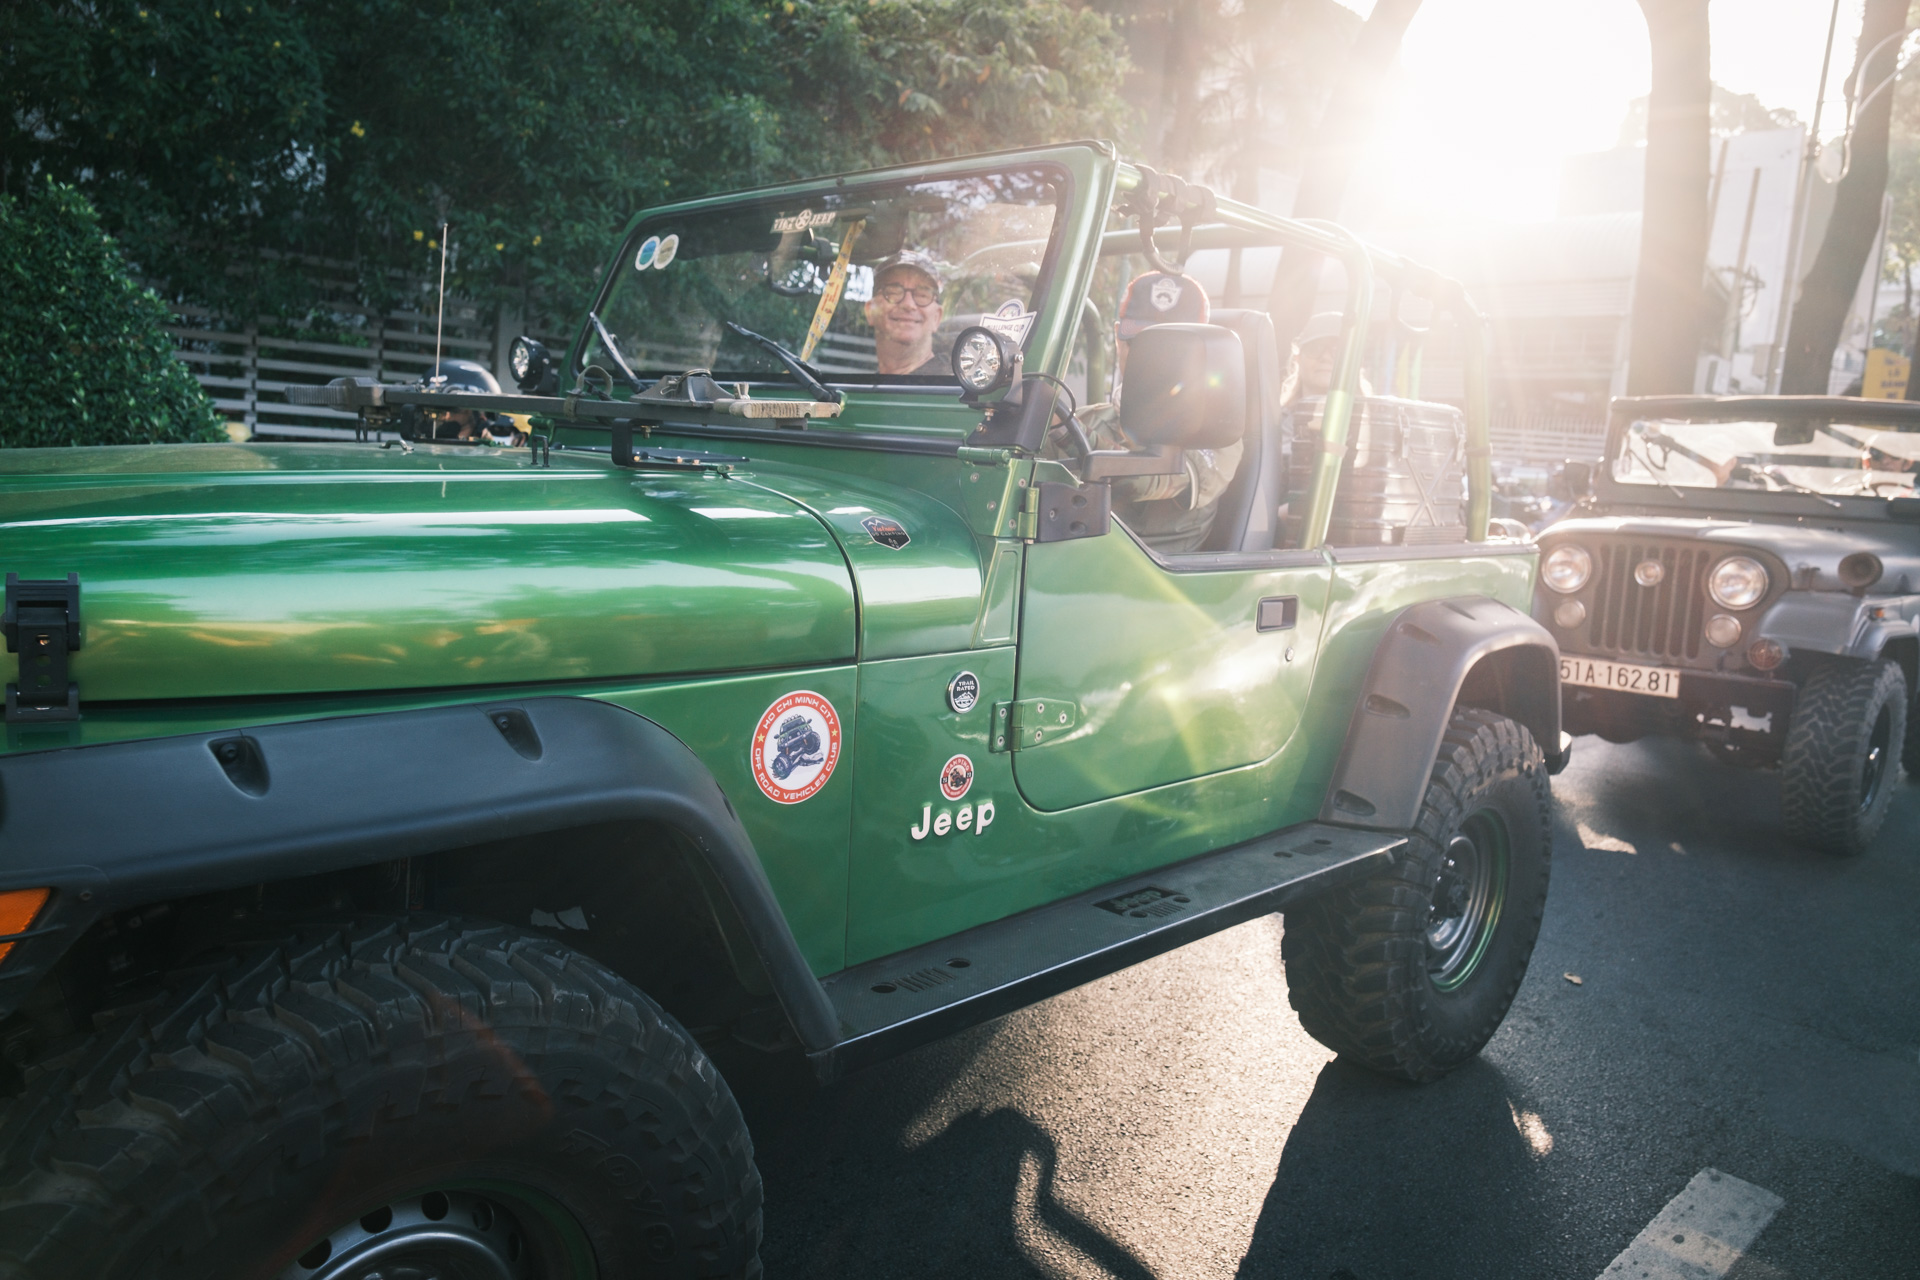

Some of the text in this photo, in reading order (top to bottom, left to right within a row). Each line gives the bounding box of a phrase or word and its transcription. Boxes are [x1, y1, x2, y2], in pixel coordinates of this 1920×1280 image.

[809, 212, 836, 226] JEEP
[1013, 324, 1025, 333] CUP
[762, 696, 835, 730] HO CHI MINH CITY
[754, 742, 838, 800] OFF ROAD VEHICLES CLUB
[945, 758, 970, 774] CAMPING
[910, 801, 996, 841] Jeep
[559, 1127, 678, 1263] TOYO
